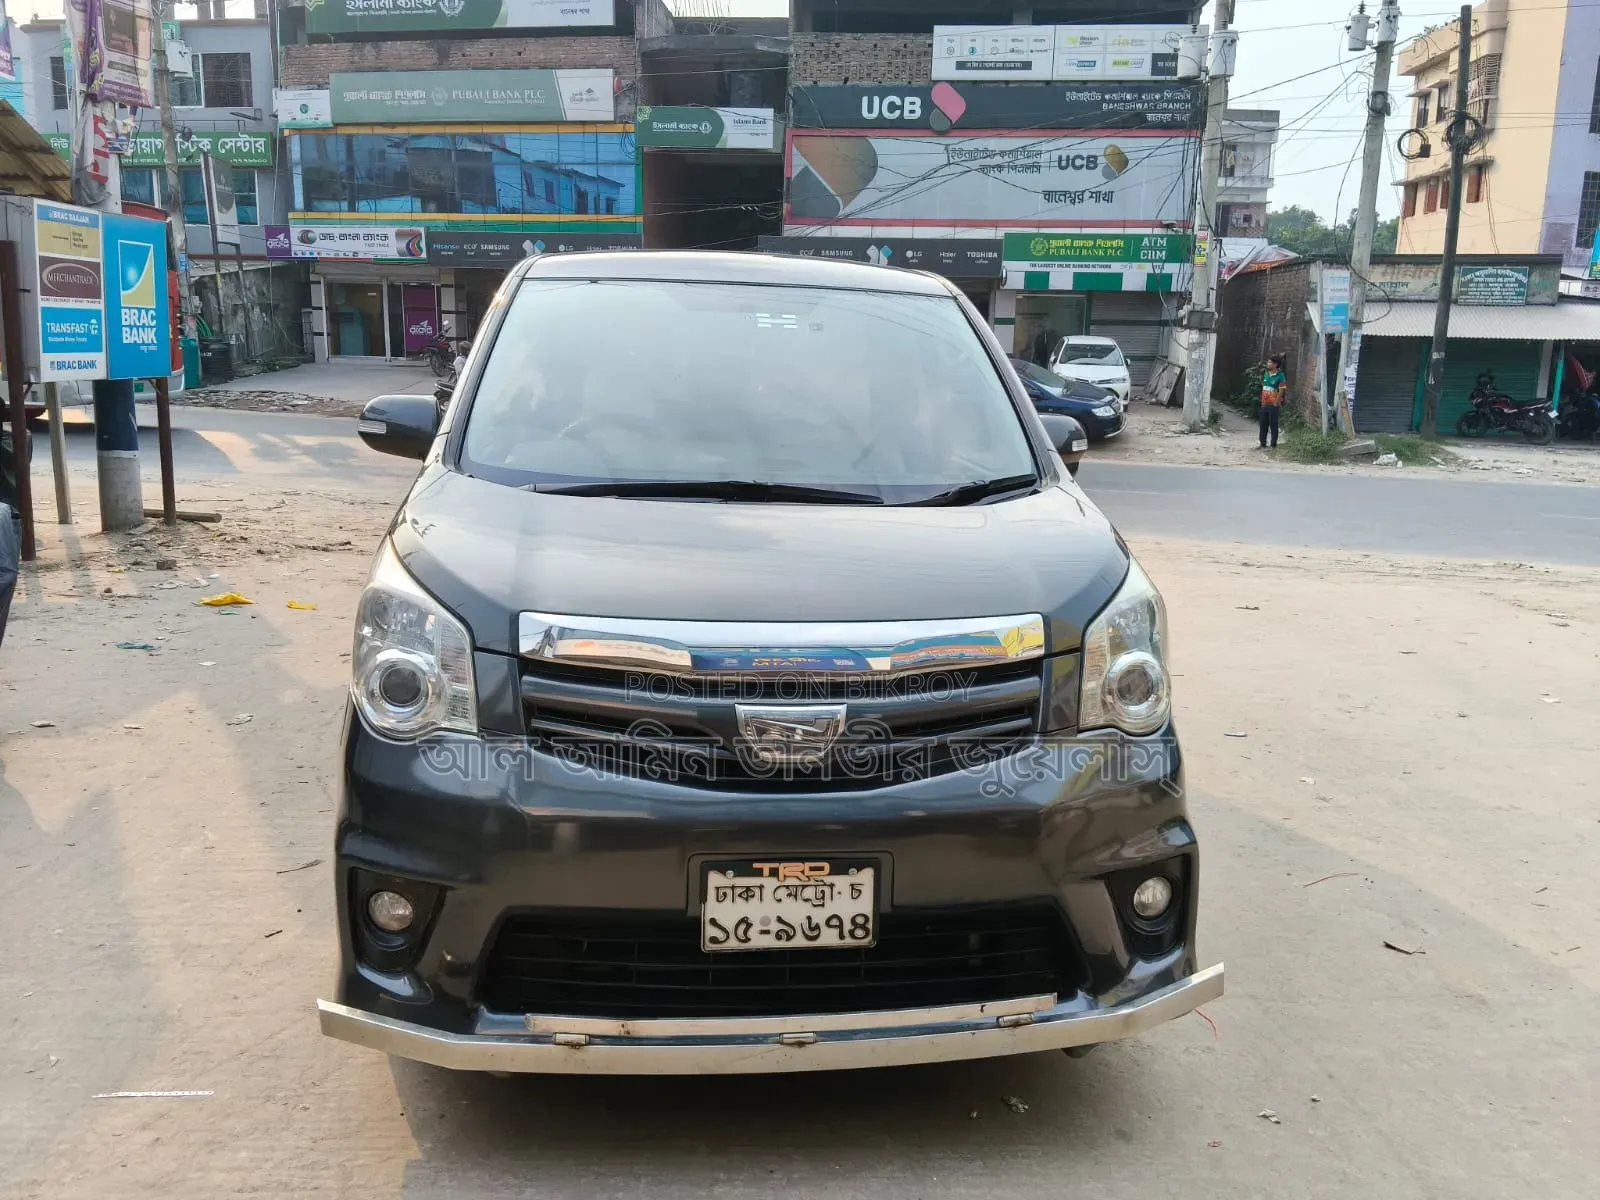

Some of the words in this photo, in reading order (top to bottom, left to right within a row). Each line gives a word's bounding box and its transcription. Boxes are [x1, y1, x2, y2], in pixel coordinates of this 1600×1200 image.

[452, 89, 491, 99] PUBALI
[493, 89, 521, 99] BANK
[861, 95, 922, 120] UCB
[1157, 102, 1191, 110] BRANCH
[1057, 153, 1098, 171] UCB
[1140, 236, 1167, 247] ATM
[1049, 249, 1079, 257] PUBALI
[1081, 249, 1105, 257] BANK
[1107, 248, 1123, 256] PLC
[121, 308, 156, 326] BRAC
[46, 322, 88, 334] TRANSFAST
[122, 327, 157, 344] BANK
[56, 359, 77, 371] BRAC
[77, 359, 97, 370] BANK
[753, 862, 830, 882] TRD
[714, 883, 765, 904] ঢাকা
[708, 913, 870, 945] ১৫-৯৬৭৪
